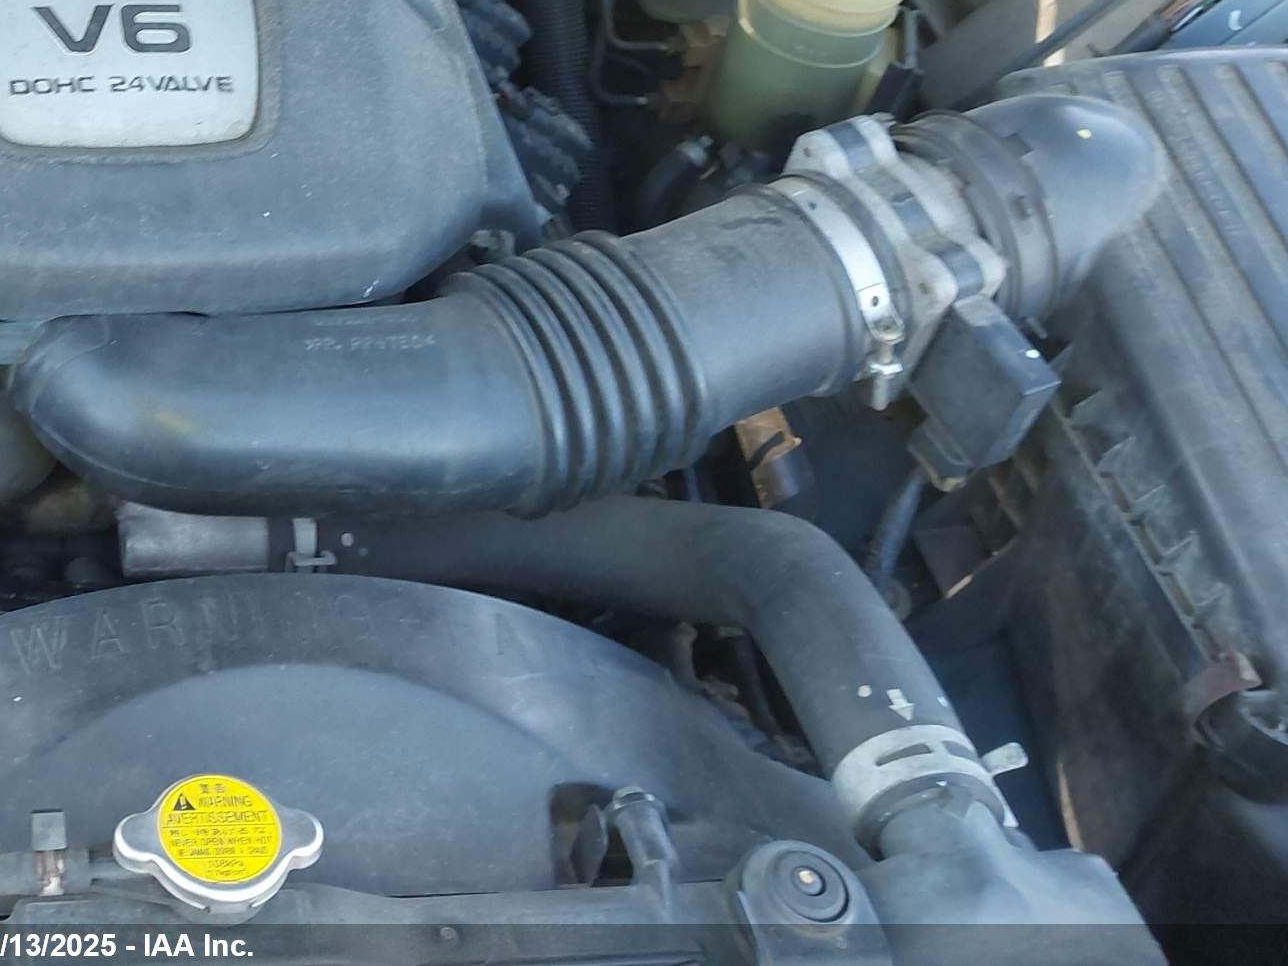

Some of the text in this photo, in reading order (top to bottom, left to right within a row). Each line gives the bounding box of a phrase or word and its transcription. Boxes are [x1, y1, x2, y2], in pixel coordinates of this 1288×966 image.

[31, 4, 192, 53] V6
[8, 75, 235, 96] DOHC 24VALVE
